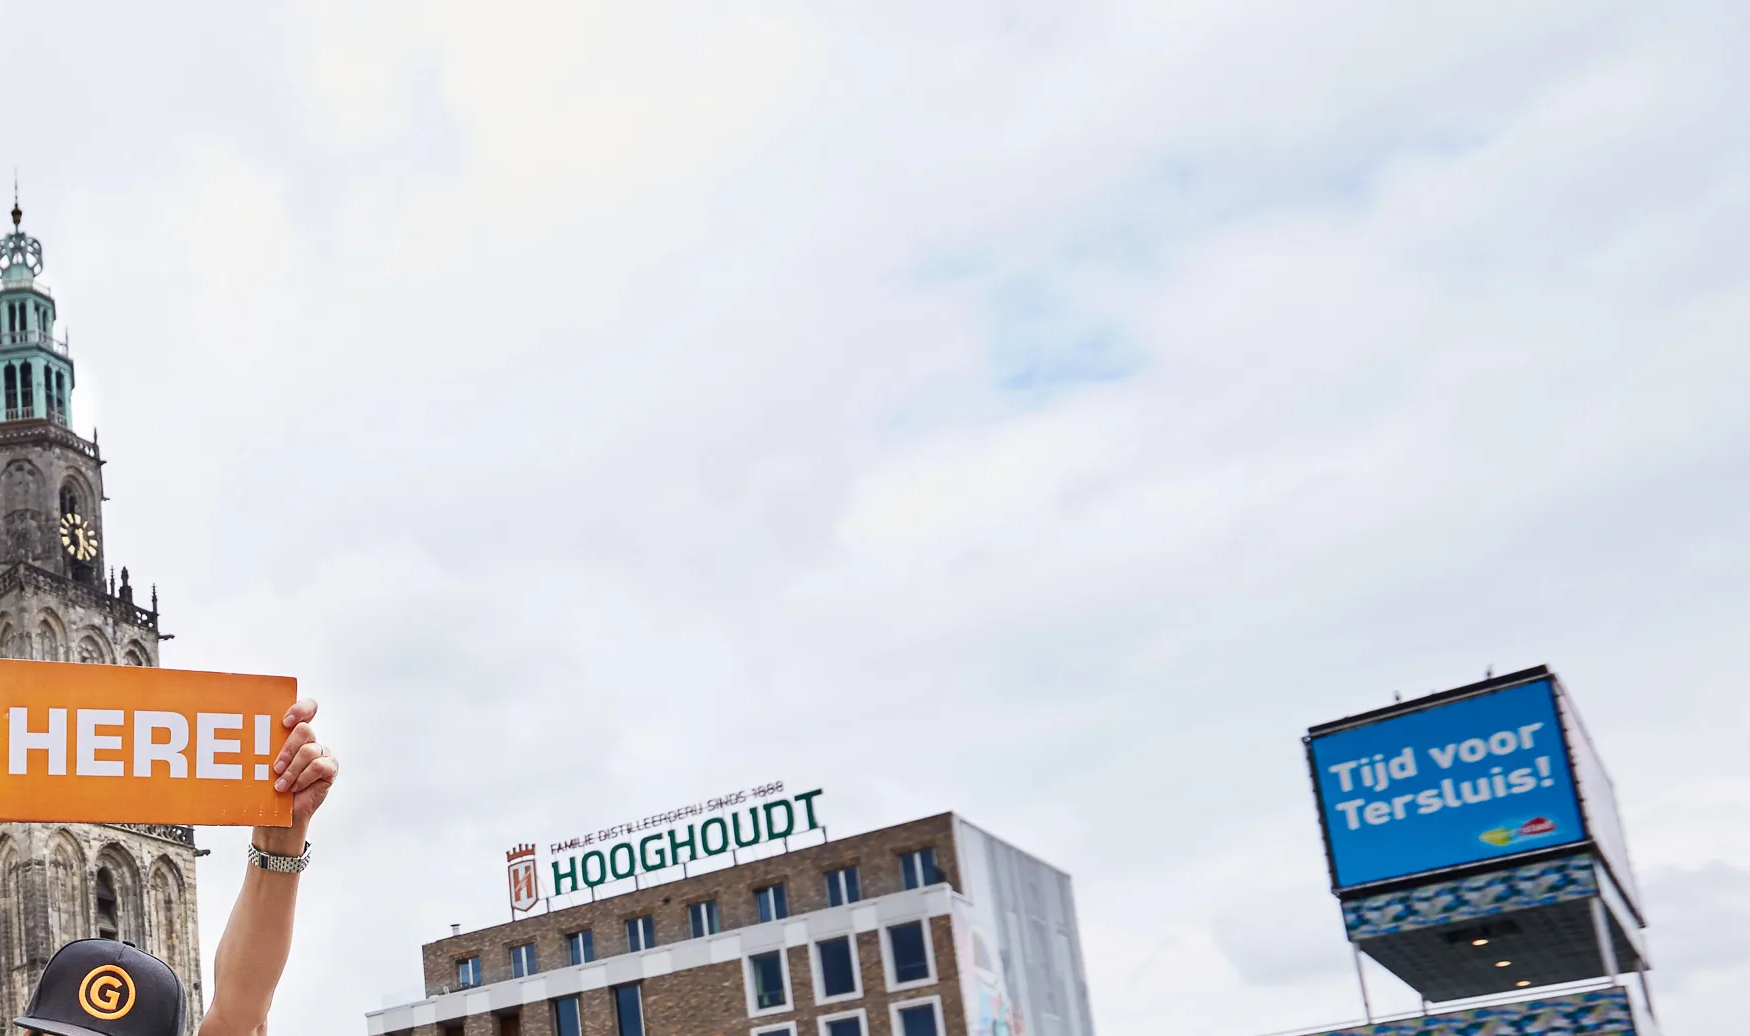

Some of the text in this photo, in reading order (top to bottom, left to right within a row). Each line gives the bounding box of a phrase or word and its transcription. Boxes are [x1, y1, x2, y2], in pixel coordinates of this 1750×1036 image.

[8, 707, 271, 781] HERE!
[1328, 722, 1544, 792] Tijd voor
[550, 832, 595, 855] FAMILIE
[707, 789, 747, 812] SINDS
[1335, 756, 1554, 830] Tersluis!
[551, 788, 823, 896] HOOGHOUDT
[90, 975, 123, 1010] G
